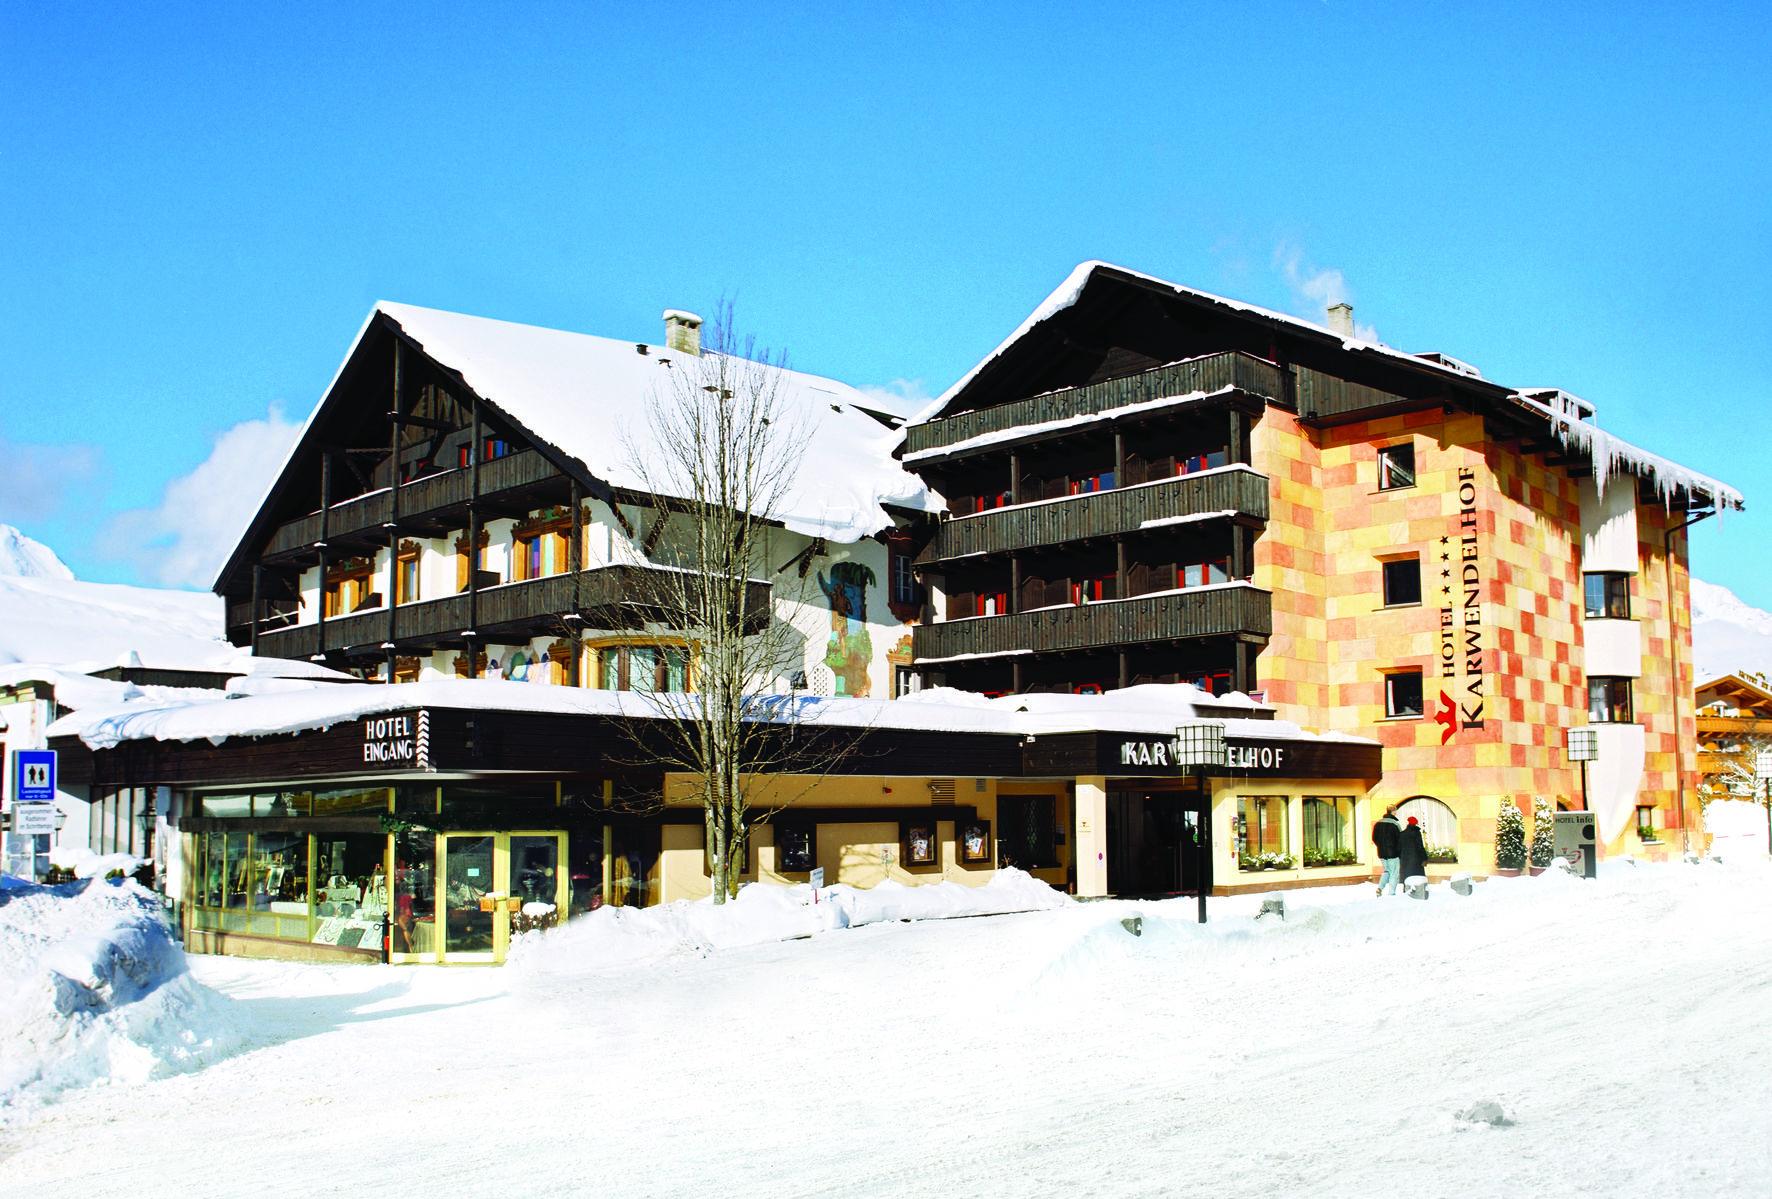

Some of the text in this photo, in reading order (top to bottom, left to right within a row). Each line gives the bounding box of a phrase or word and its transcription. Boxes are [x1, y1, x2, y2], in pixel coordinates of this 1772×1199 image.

[1458, 467, 1485, 732] KARWENDELHOF
[1440, 600, 1455, 678] HOTEL
[366, 716, 410, 740] HOTEL
[363, 740, 413, 762] EINGANG
[1576, 815, 1593, 824] info
